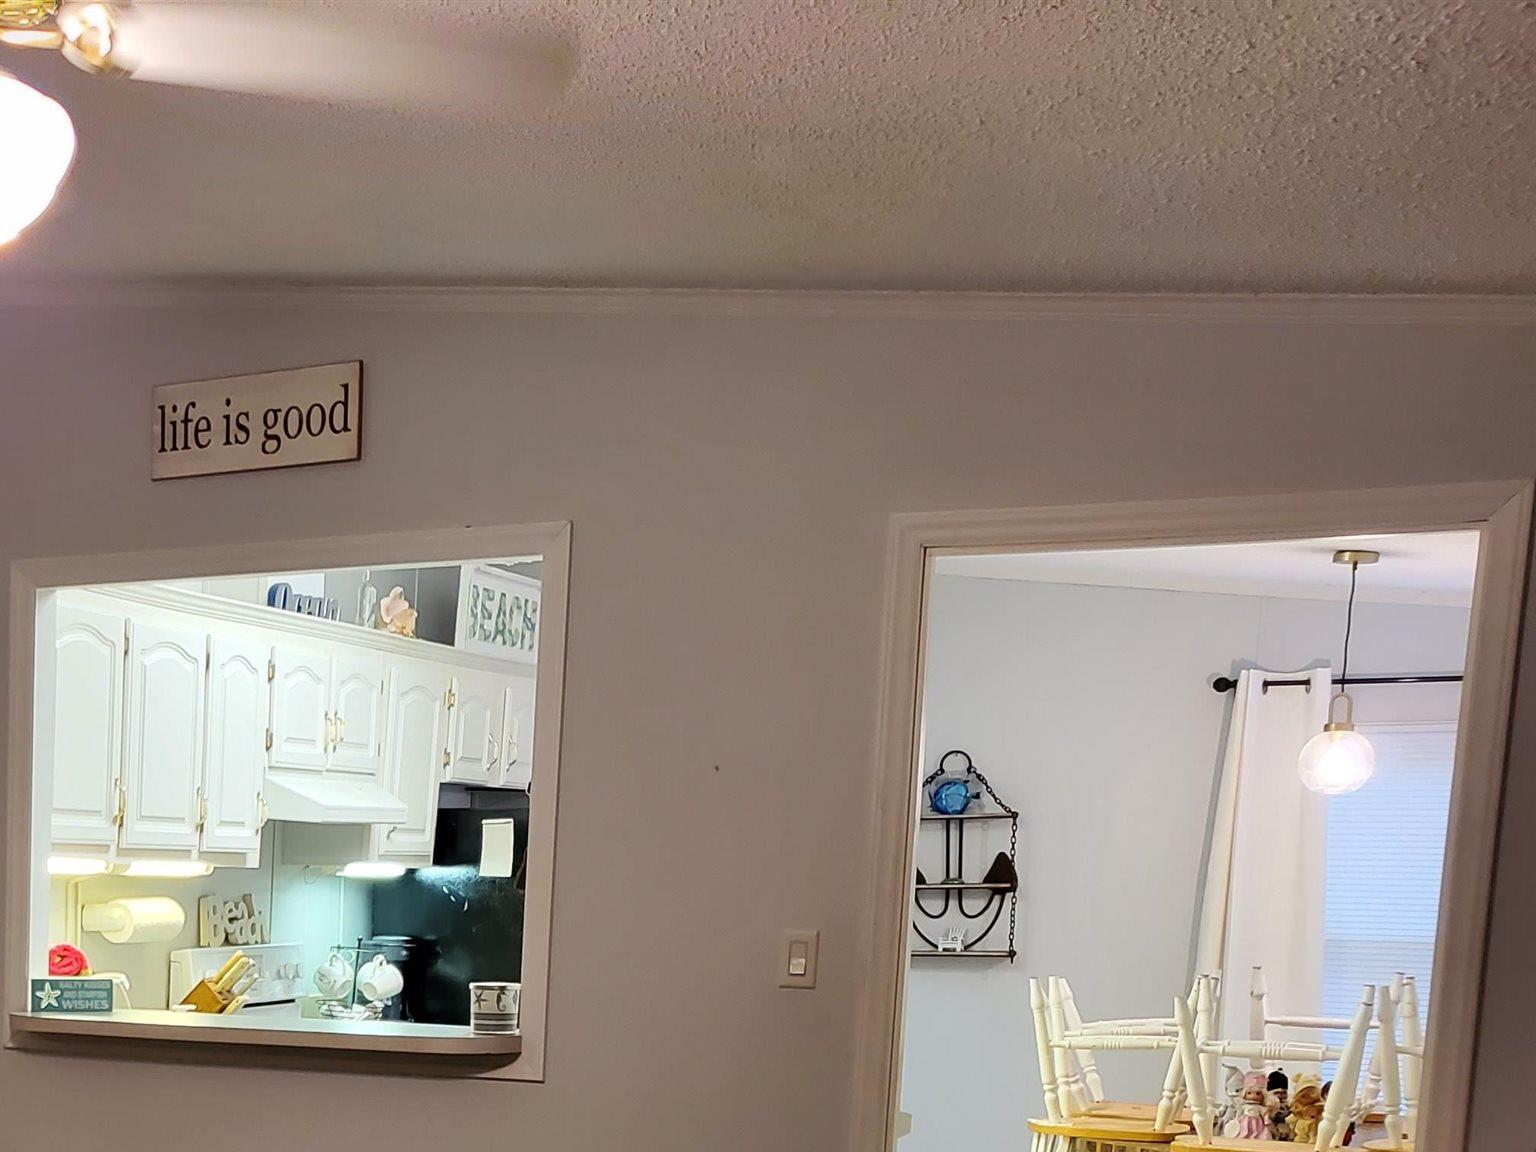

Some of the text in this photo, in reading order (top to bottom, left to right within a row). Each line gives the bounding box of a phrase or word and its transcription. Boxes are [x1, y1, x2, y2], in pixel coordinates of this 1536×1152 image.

[158, 382, 352, 455] life is good
[468, 583, 538, 652] BEACH
[61, 999, 110, 1010] WISHES
